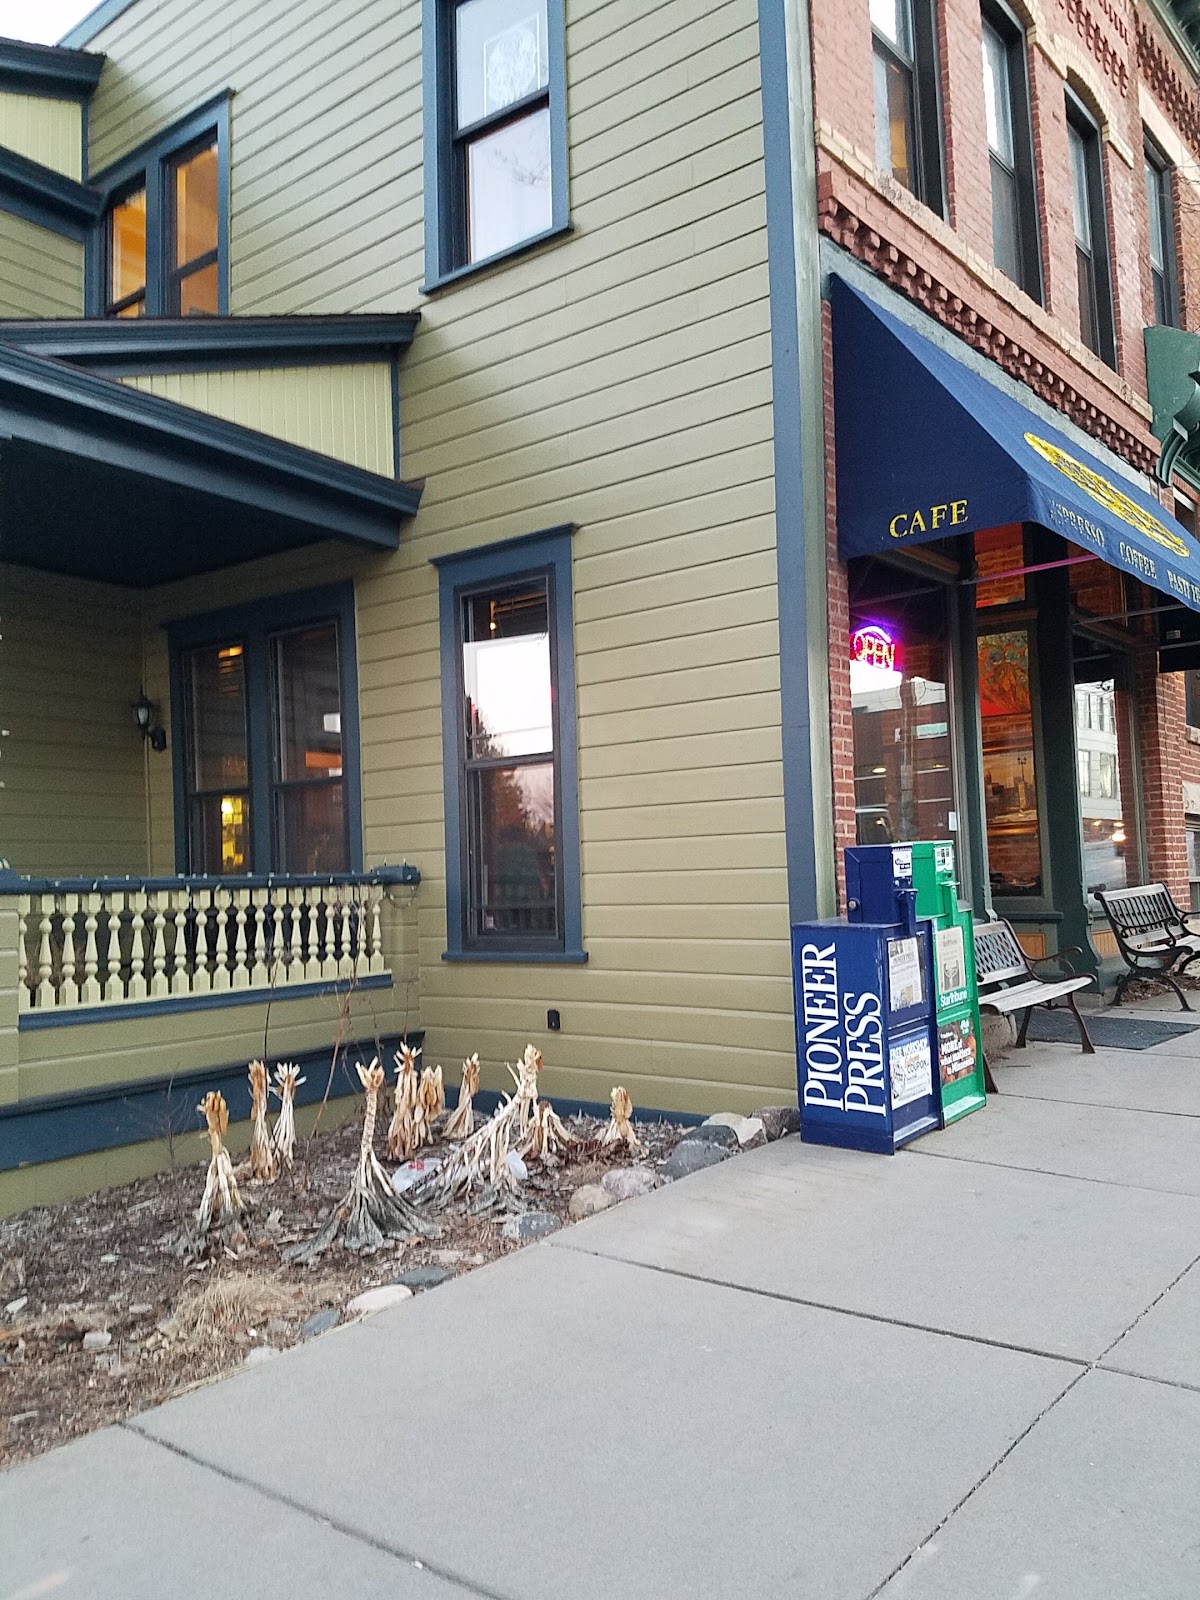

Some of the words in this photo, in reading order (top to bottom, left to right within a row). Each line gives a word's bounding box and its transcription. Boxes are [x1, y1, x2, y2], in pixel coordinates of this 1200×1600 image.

[889, 499, 969, 538] CAFE
[1119, 541, 1157, 580] COFFEE
[853, 632, 896, 672] OPEN
[801, 942, 845, 1111] PIONEER
[843, 991, 887, 1117] PRESS
